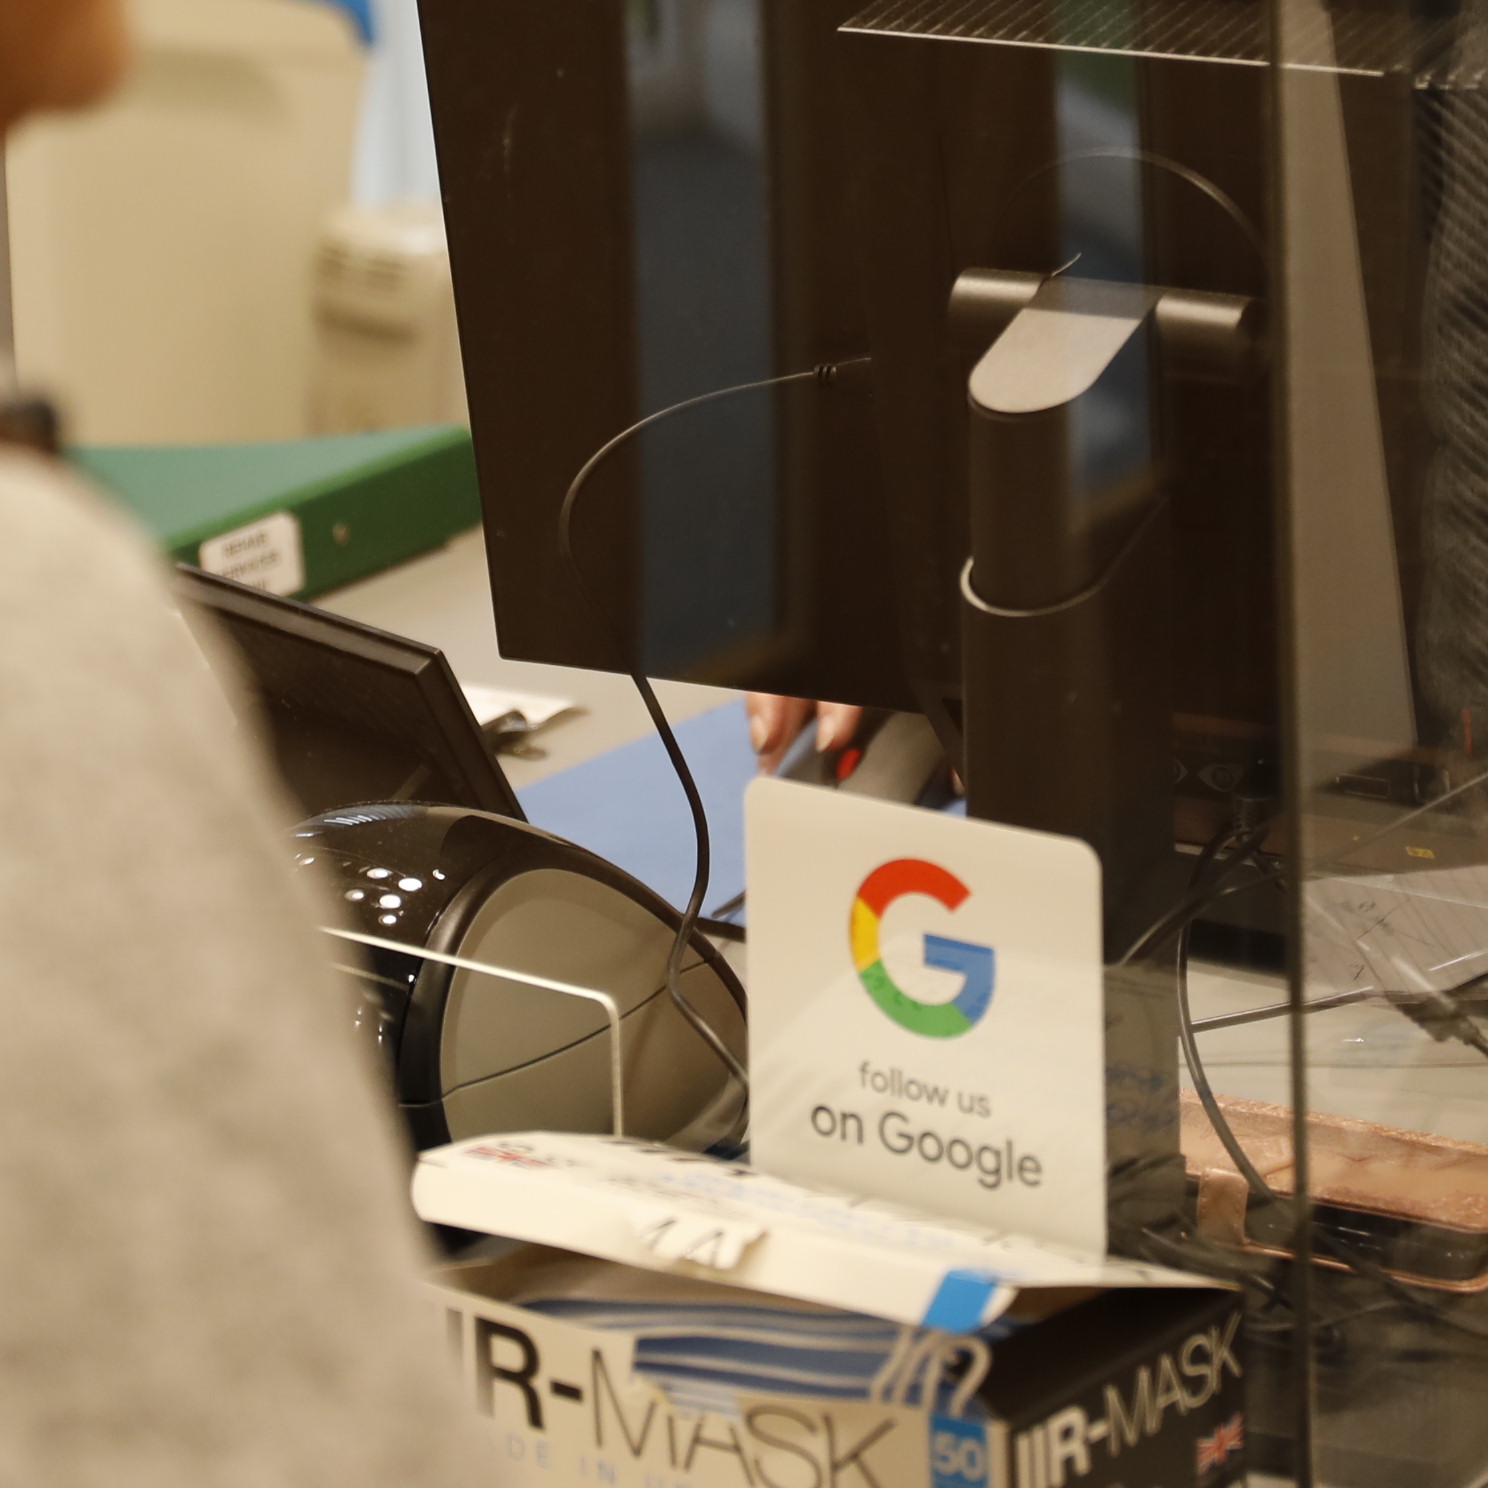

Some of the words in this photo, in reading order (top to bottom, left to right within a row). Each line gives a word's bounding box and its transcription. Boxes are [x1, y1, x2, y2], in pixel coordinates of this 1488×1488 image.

[859, 1062, 950, 1109] follow
[957, 1091, 993, 1119] us
[810, 1104, 864, 1145] on
[877, 1111, 1044, 1191] Google
[931, 1429, 988, 1483] 50
